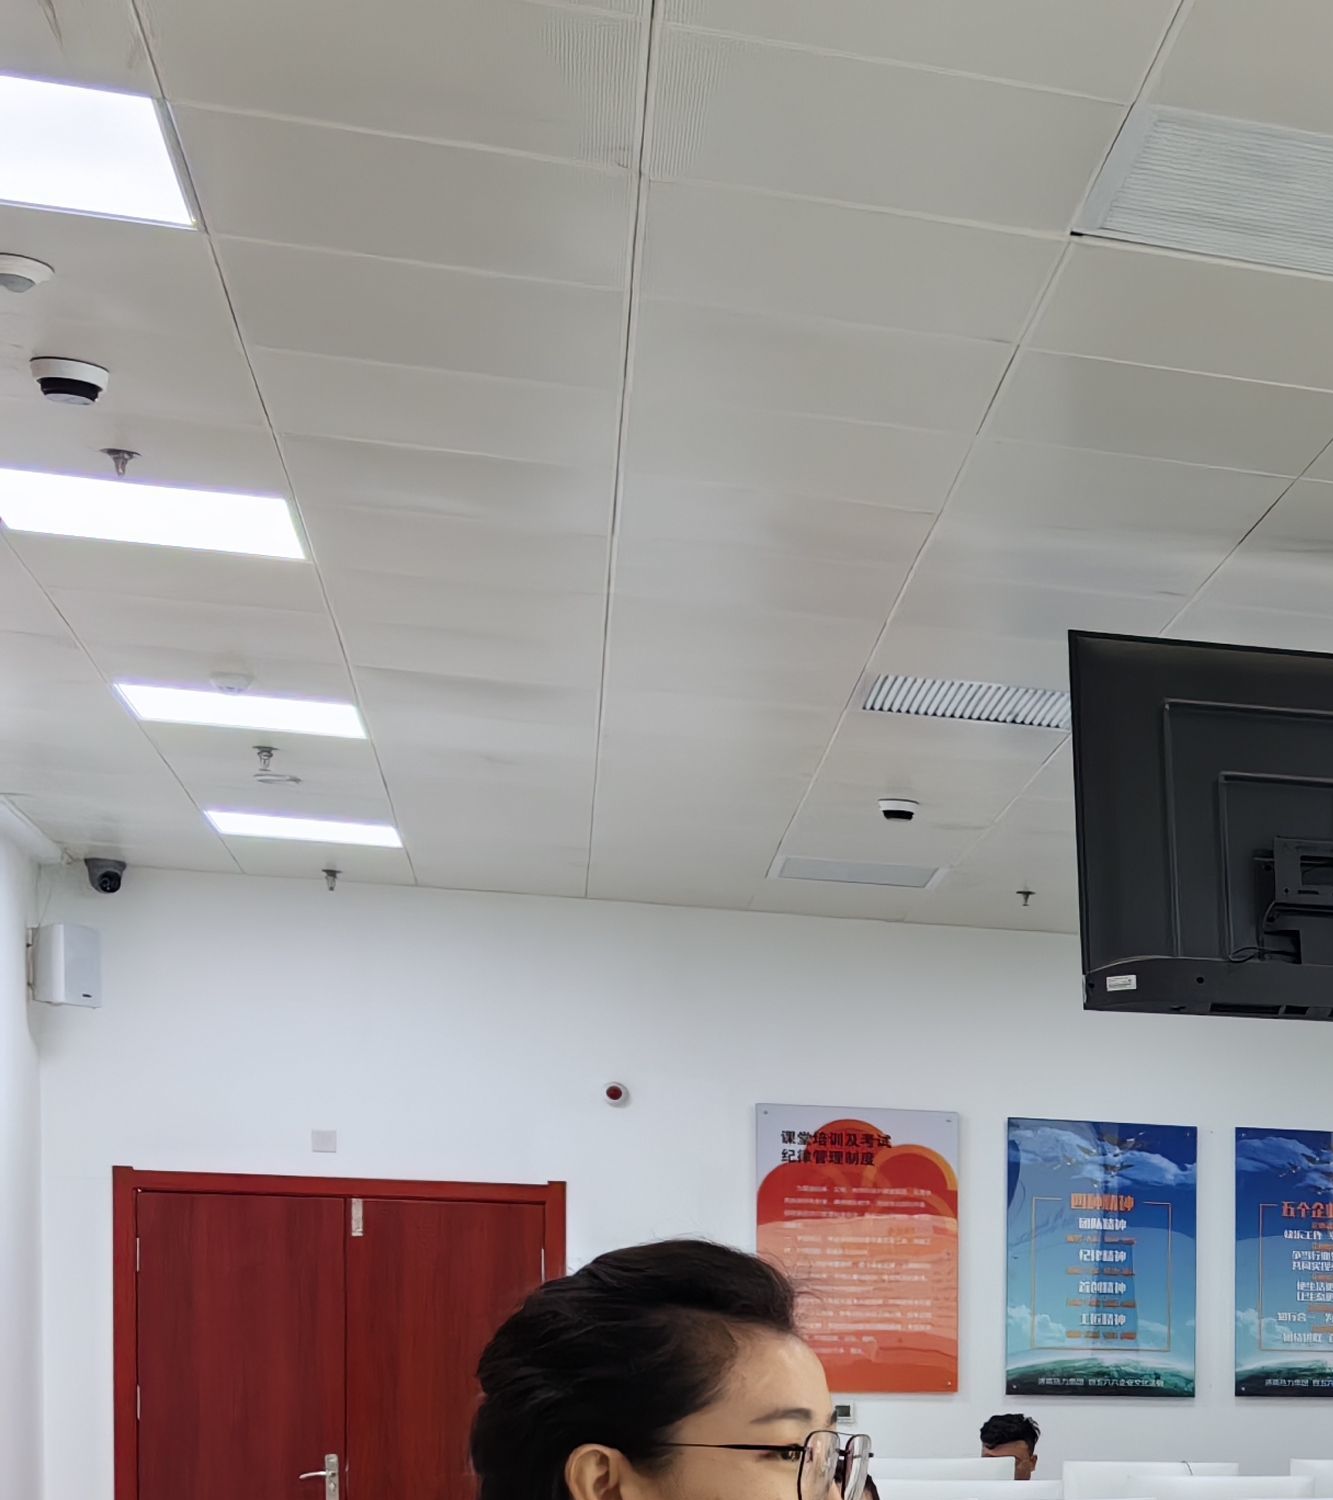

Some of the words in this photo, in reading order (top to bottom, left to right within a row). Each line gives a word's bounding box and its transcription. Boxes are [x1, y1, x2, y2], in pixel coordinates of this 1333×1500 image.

[781, 1149, 875, 1166] 纪律管理制度
